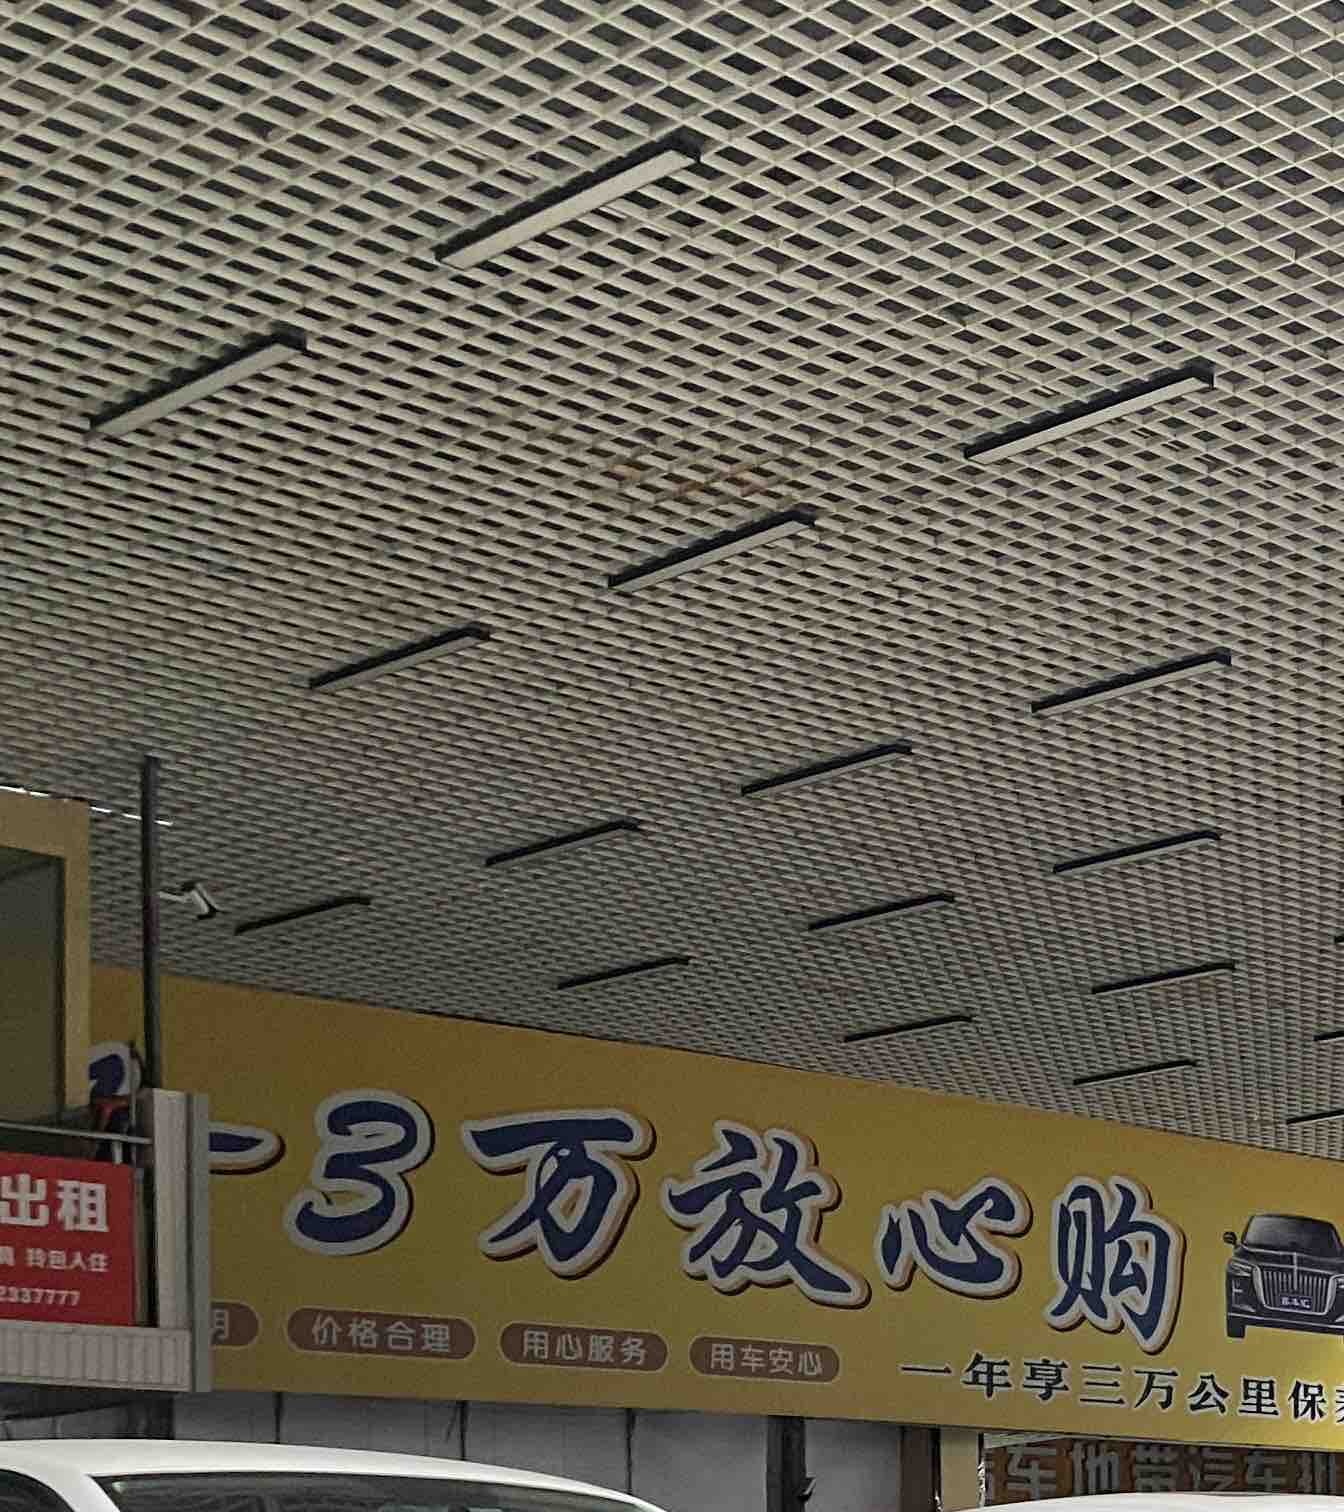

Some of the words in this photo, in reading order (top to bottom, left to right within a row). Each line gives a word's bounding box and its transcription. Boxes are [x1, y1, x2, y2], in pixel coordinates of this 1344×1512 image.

[0, 1173, 109, 1232] 出租
[311, 1315, 452, 1354] 价格合理
[521, 1329, 649, 1367] 用心服务
[709, 1342, 824, 1376] 用车安心
